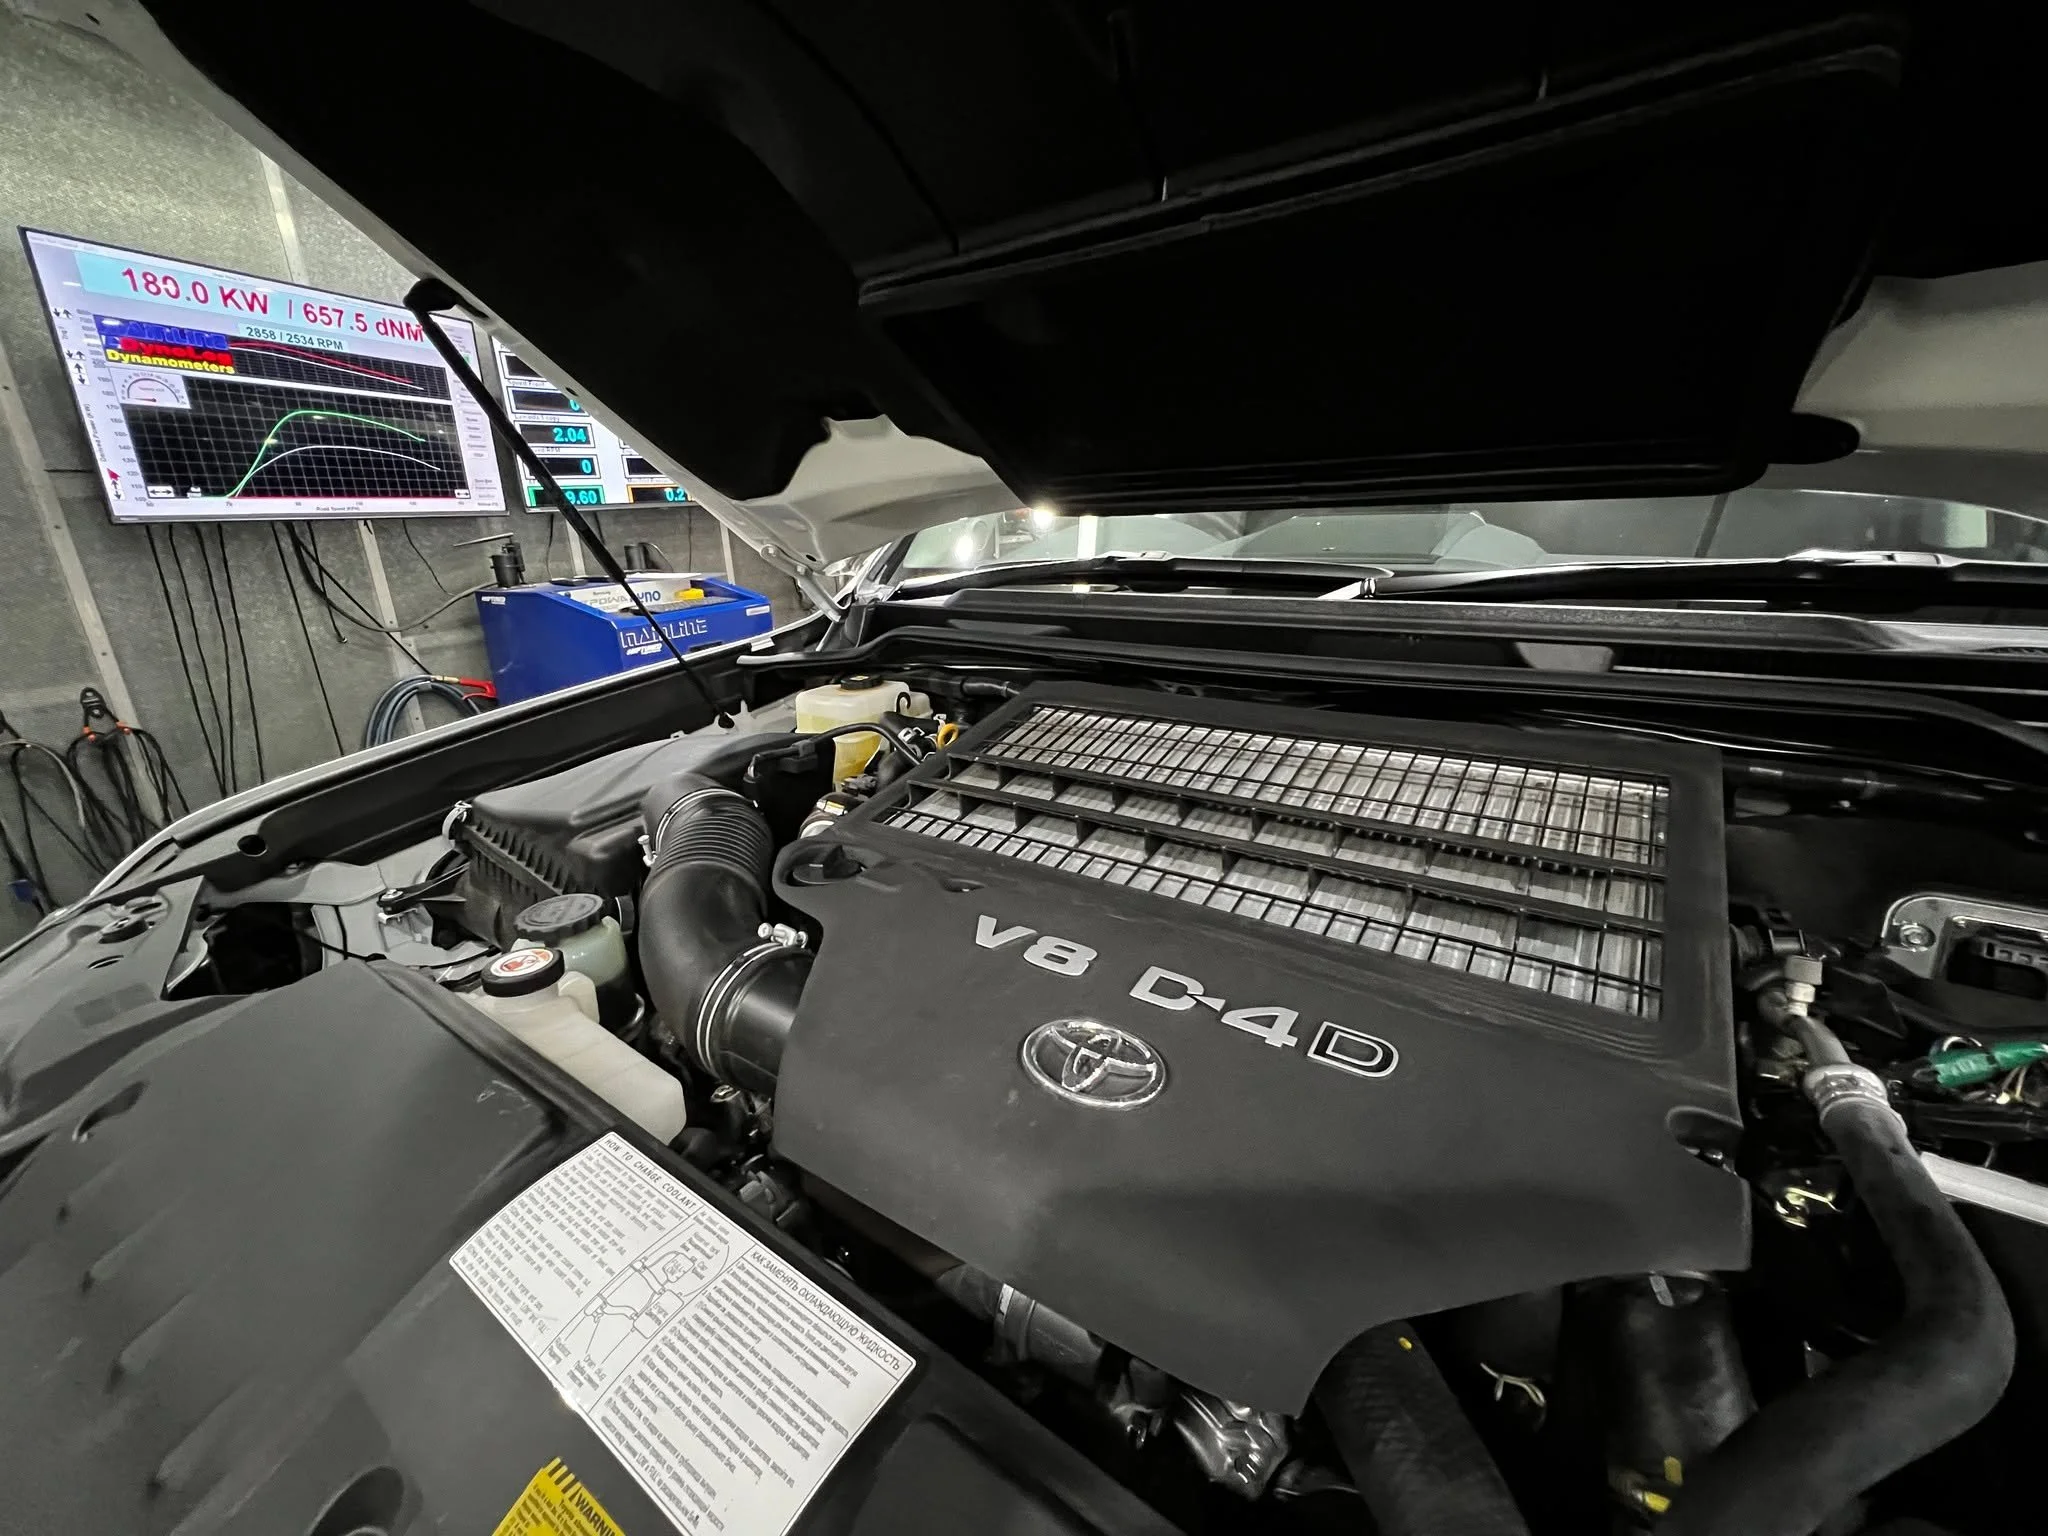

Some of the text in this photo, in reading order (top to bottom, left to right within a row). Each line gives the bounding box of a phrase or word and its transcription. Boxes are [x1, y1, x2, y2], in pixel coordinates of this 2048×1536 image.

[121, 267, 209, 305] 180.0
[218, 285, 268, 315] KW
[303, 302, 368, 333] 657.5
[246, 326, 276, 341] 2858
[286, 333, 314, 347] 2534
[317, 337, 344, 351] RPM
[105, 349, 235, 375] Dynamometers
[553, 427, 587, 443] 2.04
[581, 460, 592, 475] 0
[975, 914, 1400, 1078] V8 D-4D
[603, 1137, 694, 1209] HOW TO CHANGE COOLANT
[749, 1249, 767, 1266] КАК
[763, 1260, 798, 1291] ЗАМЕНЯТЬ
[798, 1288, 858, 1337] ОХЛАЖДАЮЩУЮ
[856, 1332, 900, 1370] ЖИДКОСТЬ
